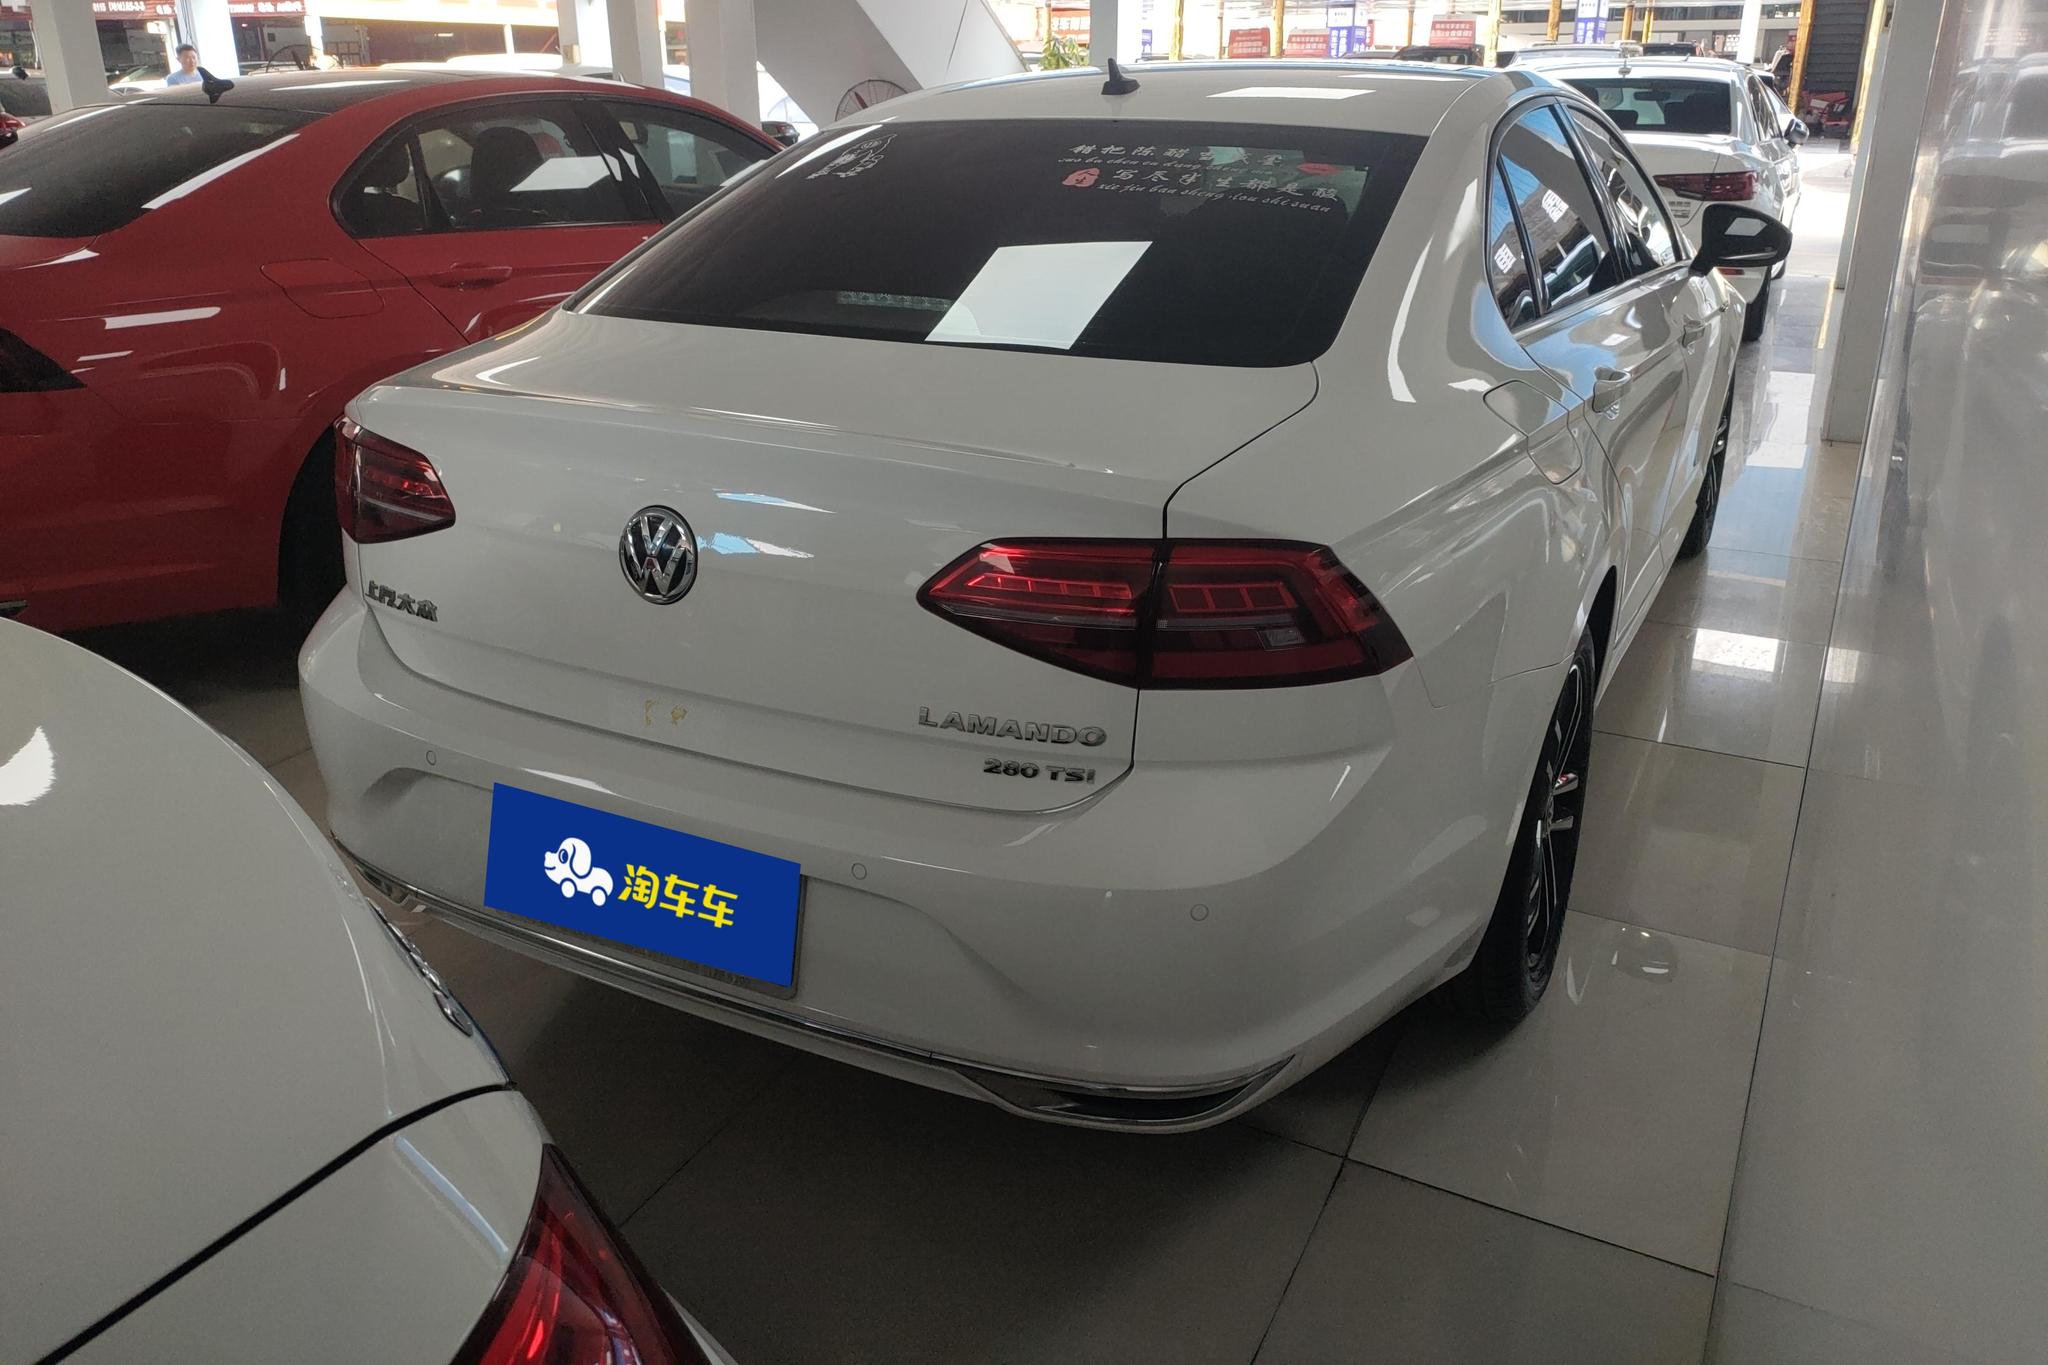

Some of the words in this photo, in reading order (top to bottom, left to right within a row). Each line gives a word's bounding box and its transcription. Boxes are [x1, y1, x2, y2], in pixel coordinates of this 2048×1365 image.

[918, 705, 1107, 747] LAMANDO
[983, 757, 1040, 779] 280
[1046, 764, 1096, 785] TSI
